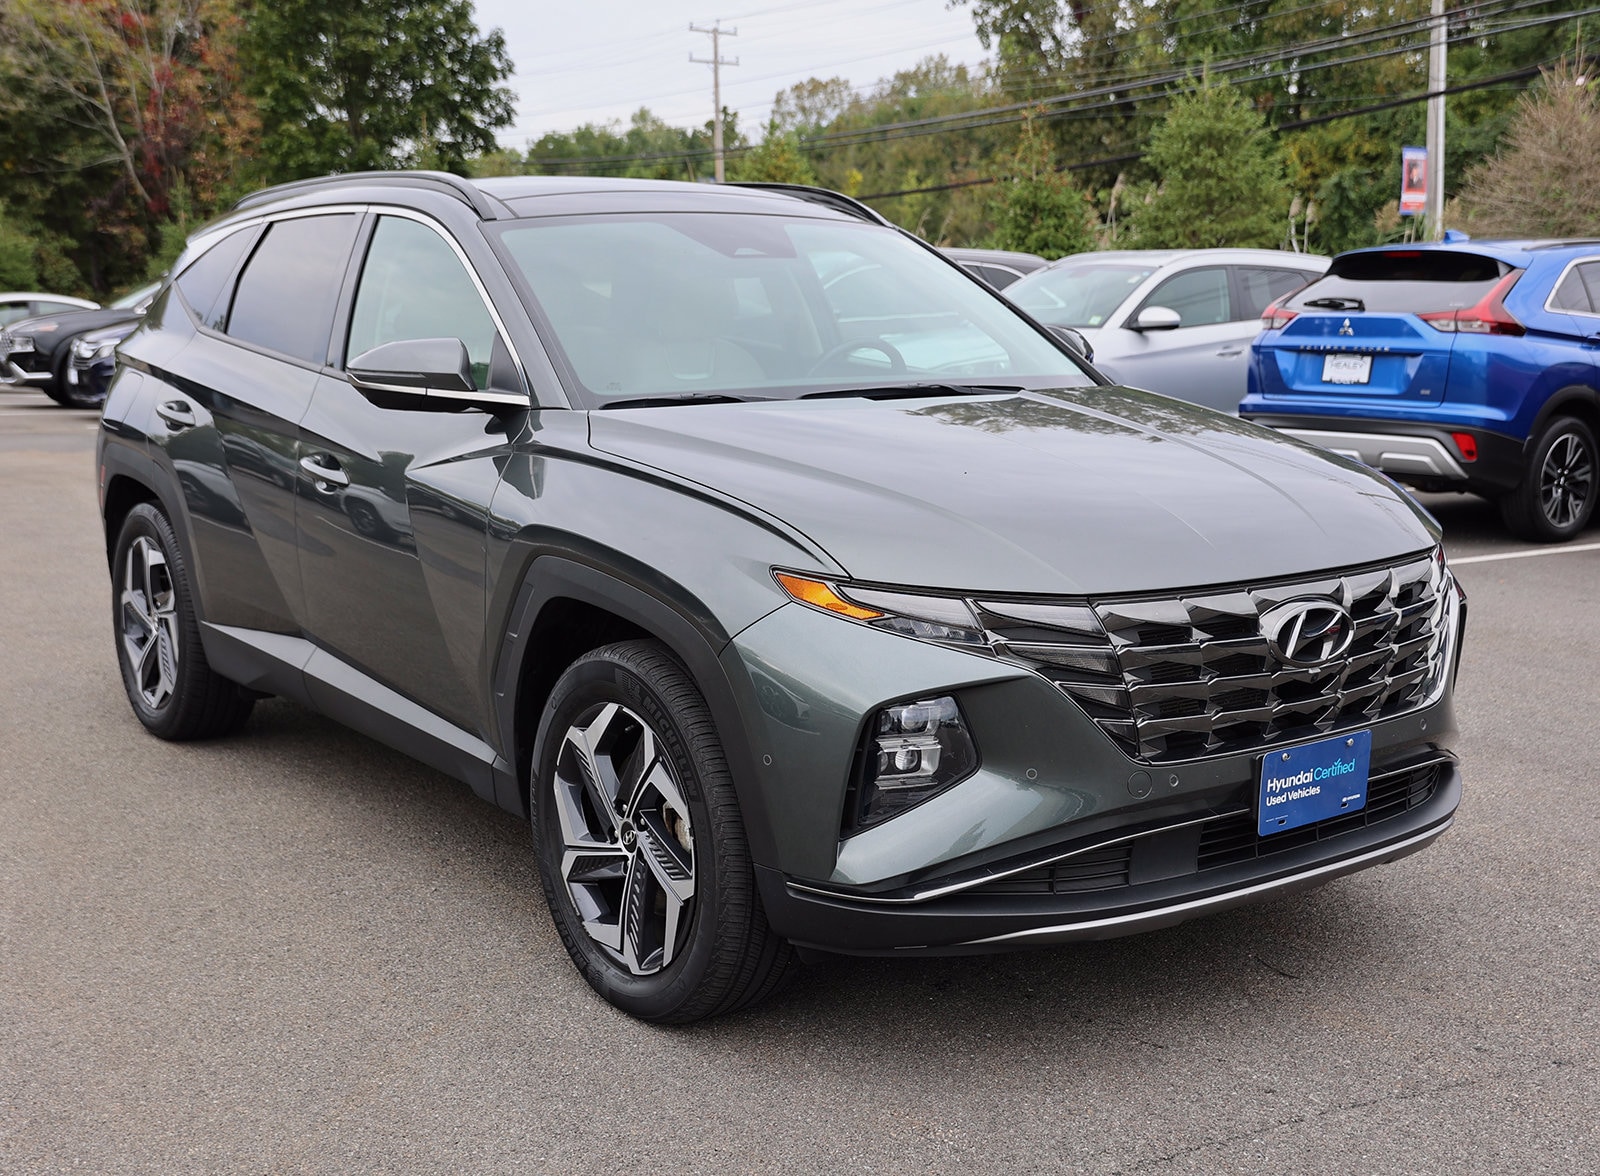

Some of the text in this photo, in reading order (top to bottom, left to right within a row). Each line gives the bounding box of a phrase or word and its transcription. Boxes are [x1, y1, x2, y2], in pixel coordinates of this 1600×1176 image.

[1329, 360, 1364, 370] HEALEY
[642, 695, 699, 799] MICHELIN
[1267, 758, 1355, 793] Hyundai Certified
[1266, 785, 1321, 807] Used Vehicles
